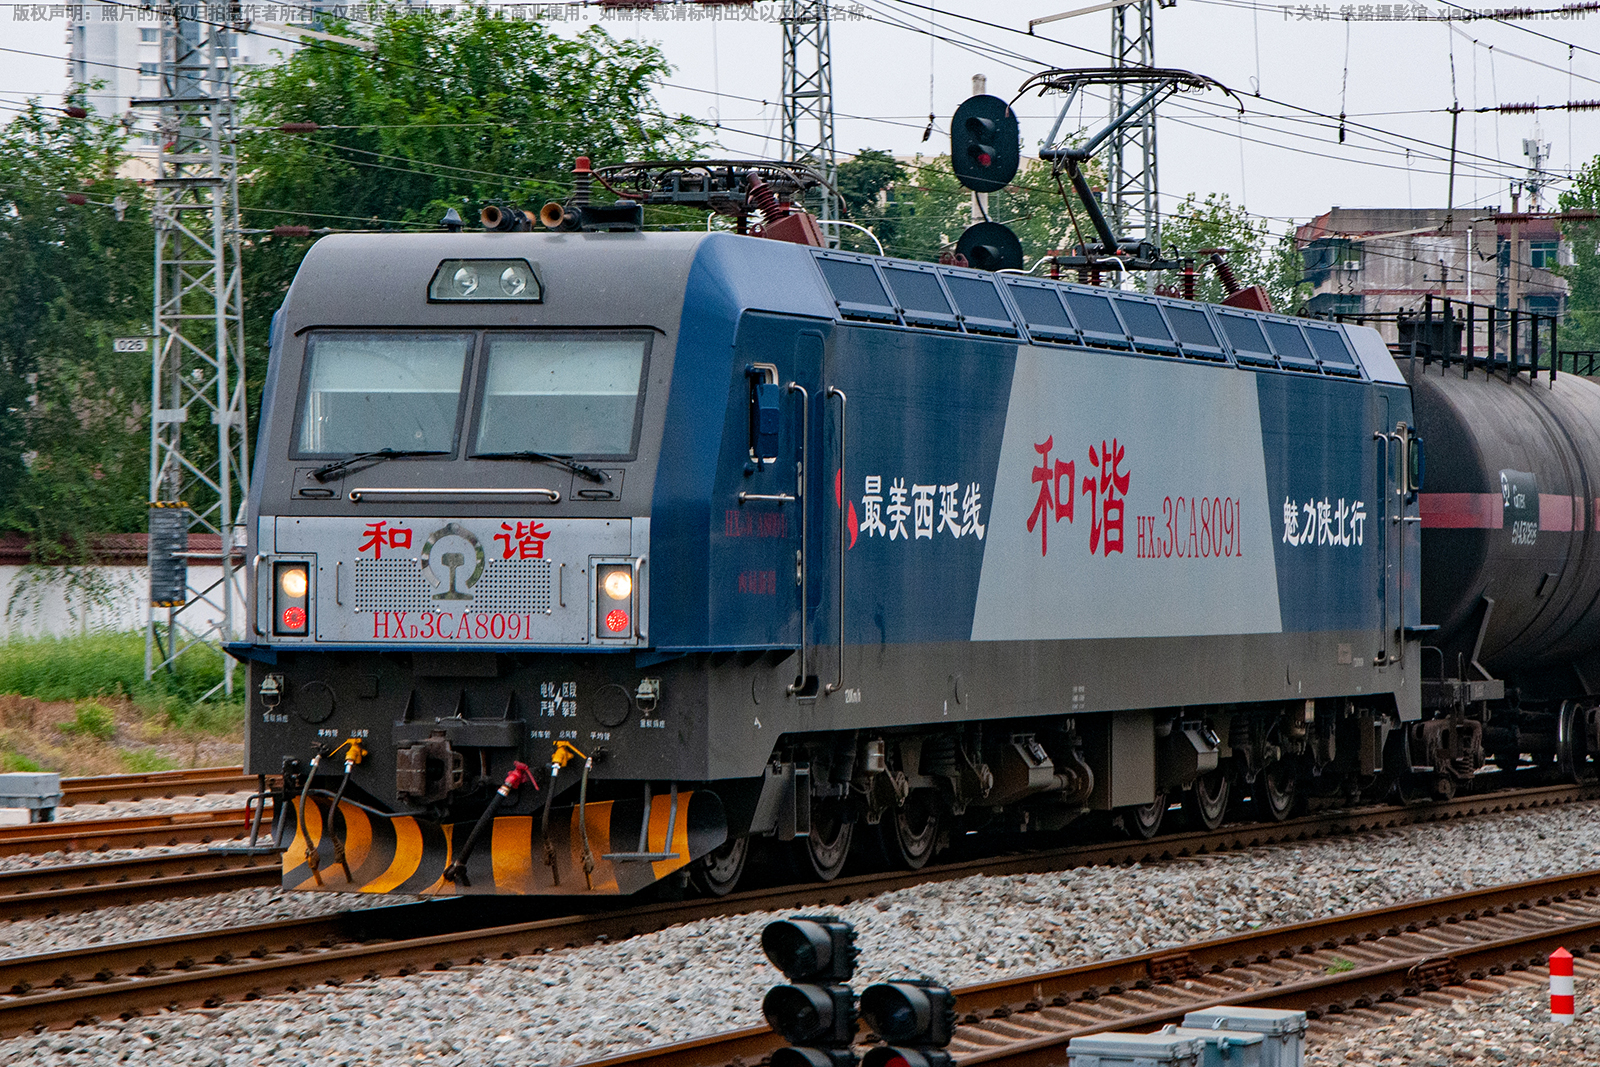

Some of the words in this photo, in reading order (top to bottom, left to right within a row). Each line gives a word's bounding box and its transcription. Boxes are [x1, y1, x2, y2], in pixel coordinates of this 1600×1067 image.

[860, 474, 986, 541] 最美西延线
[1027, 434, 1132, 558] 和谐
[1282, 495, 1367, 547] 魅力陕北行
[358, 520, 413, 560] 和
[493, 520, 552, 560] 谐
[372, 611, 534, 640] HXD3CA8091
